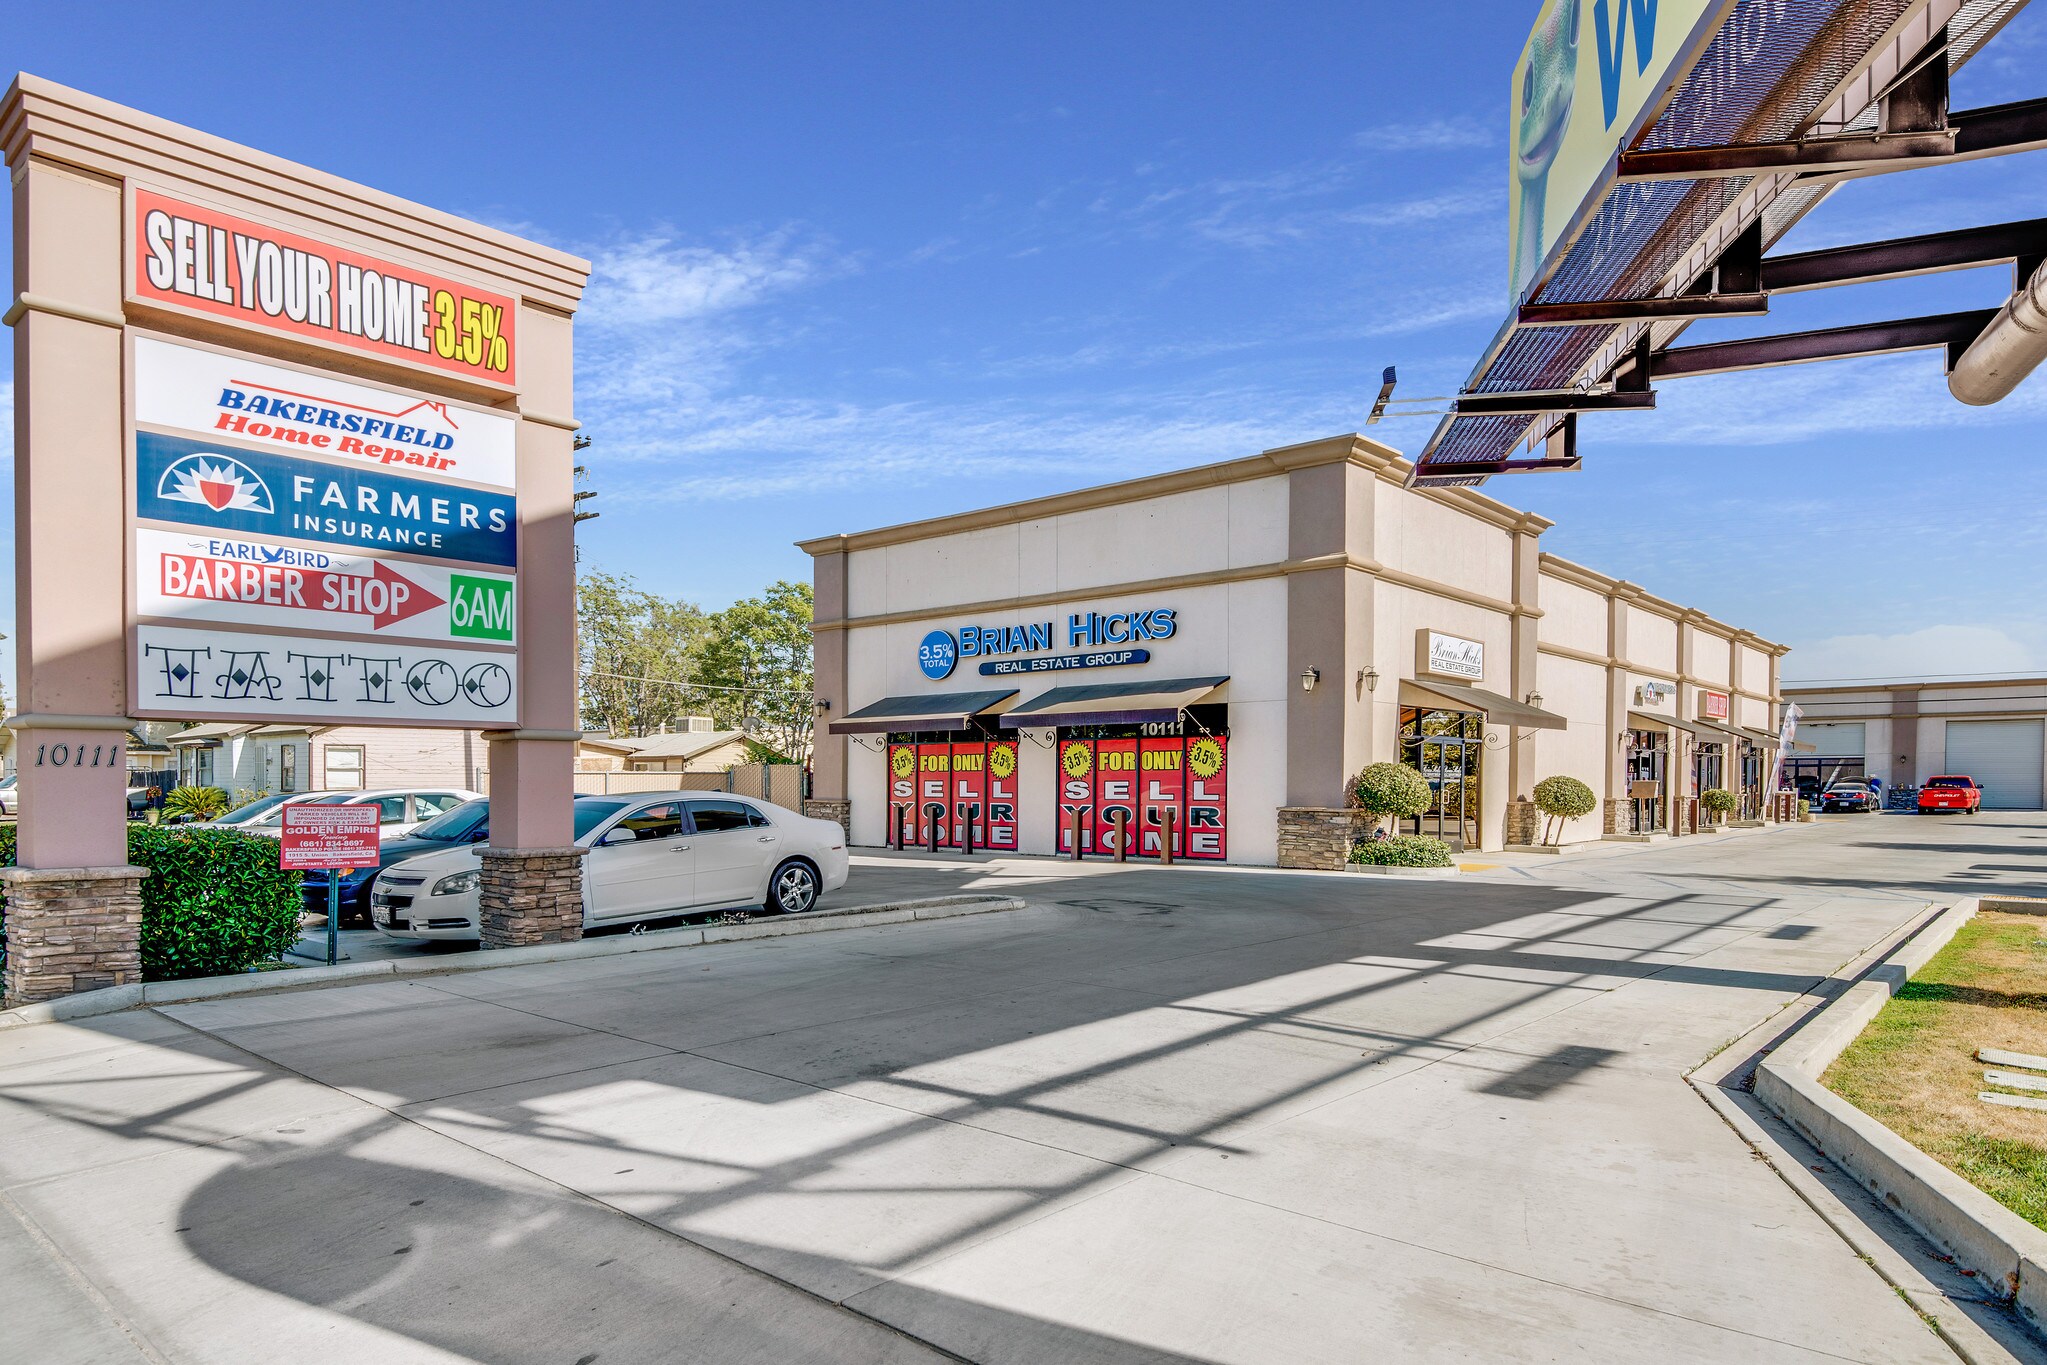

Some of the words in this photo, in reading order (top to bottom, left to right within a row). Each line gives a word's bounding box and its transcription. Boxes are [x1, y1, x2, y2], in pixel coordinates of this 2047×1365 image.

[145, 209, 235, 306] SELL
[232, 231, 333, 330] YOUR
[337, 261, 431, 354] HOME
[434, 289, 508, 372] 3.5%
[217, 388, 454, 450] BAKERSFIELD
[214, 413, 331, 448] Home
[337, 436, 456, 471] Repair
[293, 475, 507, 533] FARMERS
[293, 513, 442, 548] INSURANCE
[284, 550, 330, 569] BIRD
[164, 556, 307, 607] BARBER
[322, 574, 410, 616] SHOP
[452, 585, 511, 631] 6AM
[959, 622, 1050, 657] BRIAN
[1068, 607, 1175, 647] HICKS
[920, 643, 953, 660] 3.5%
[995, 662, 1026, 673] REAL
[1031, 657, 1080, 670] ESTATE
[1085, 652, 1132, 666] GROUP
[1431, 636, 1457, 660] Brian
[1458, 641, 1481, 665] Hicks
[145, 643, 511, 708] TATTOO
[923, 659, 949, 668] TOTAL
[1431, 660, 1444, 669] REAL
[1445, 662, 1464, 672] ESTATE
[1465, 666, 1481, 675] GROUP
[1140, 722, 1184, 736] 10111
[35, 743, 119, 768] 10111
[895, 752, 912, 771] 3.5%
[919, 755, 949, 772] FOR
[952, 754, 985, 772] ONLY
[993, 751, 1011, 770] 3.5%
[1066, 751, 1088, 770] 3.5%
[1098, 751, 1136, 771] FOR
[1141, 750, 1183, 771] ONLY
[1193, 746, 1217, 769] 3.5%
[893, 780, 1013, 798] SELL
[1065, 780, 1220, 801] SELL
[890, 801, 1016, 823] YOUR
[1060, 804, 1224, 829] YOUR
[286, 826, 334, 835] GOLDEN
[337, 826, 377, 834] EMPIRE
